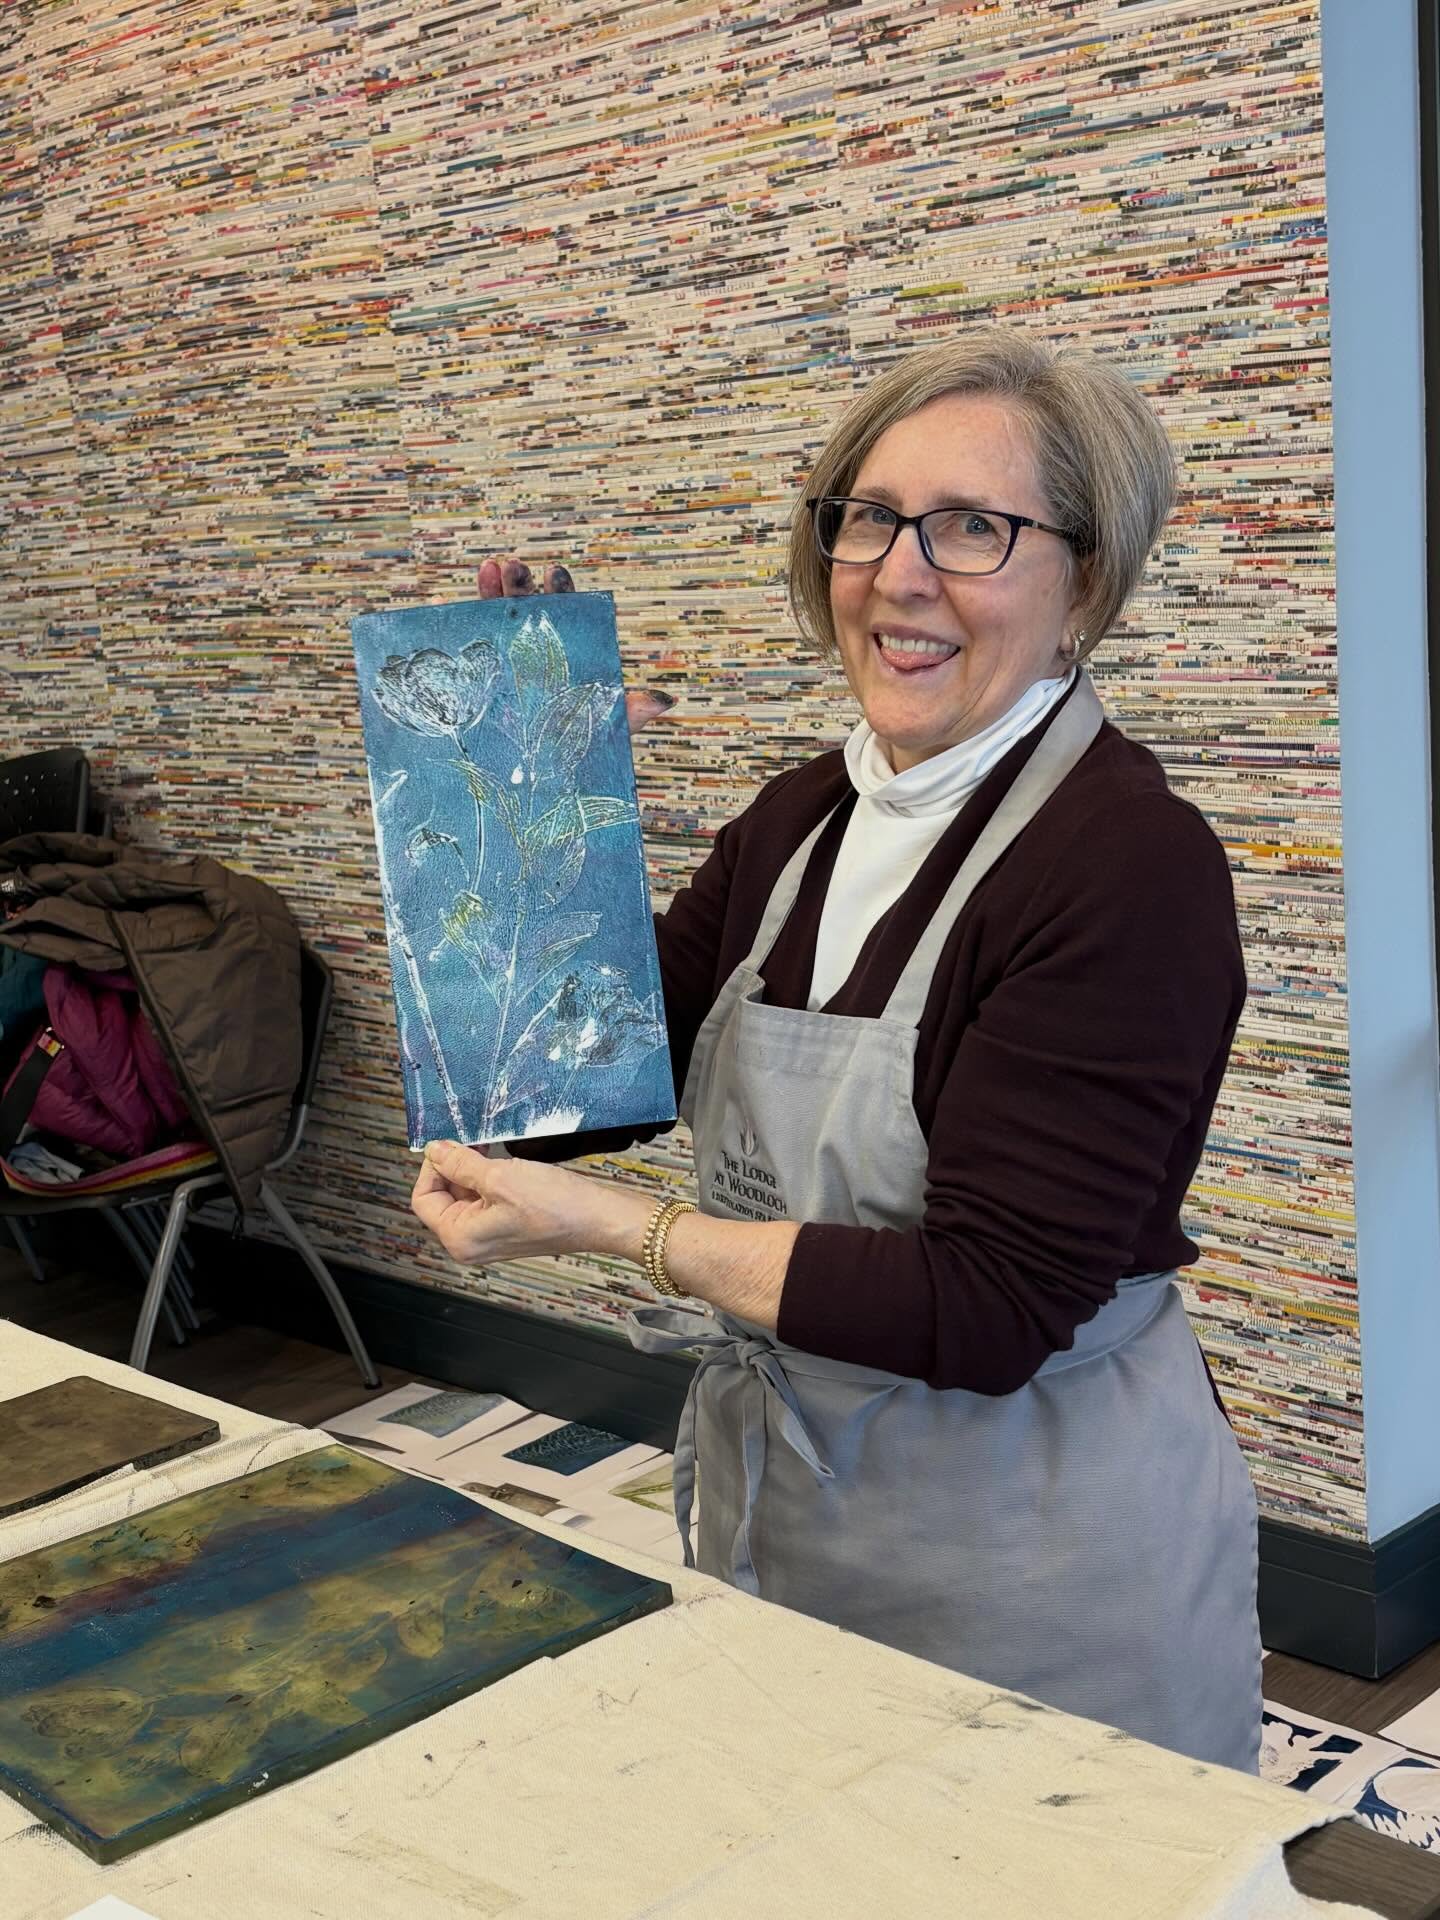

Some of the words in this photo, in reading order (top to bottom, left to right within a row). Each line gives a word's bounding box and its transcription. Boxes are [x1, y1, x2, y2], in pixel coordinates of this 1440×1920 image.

[721, 1150, 739, 1173] THE
[742, 1160, 776, 1188] LODGE
[714, 1170, 724, 1186] AT
[728, 1172, 787, 1214] WOODLOCH
